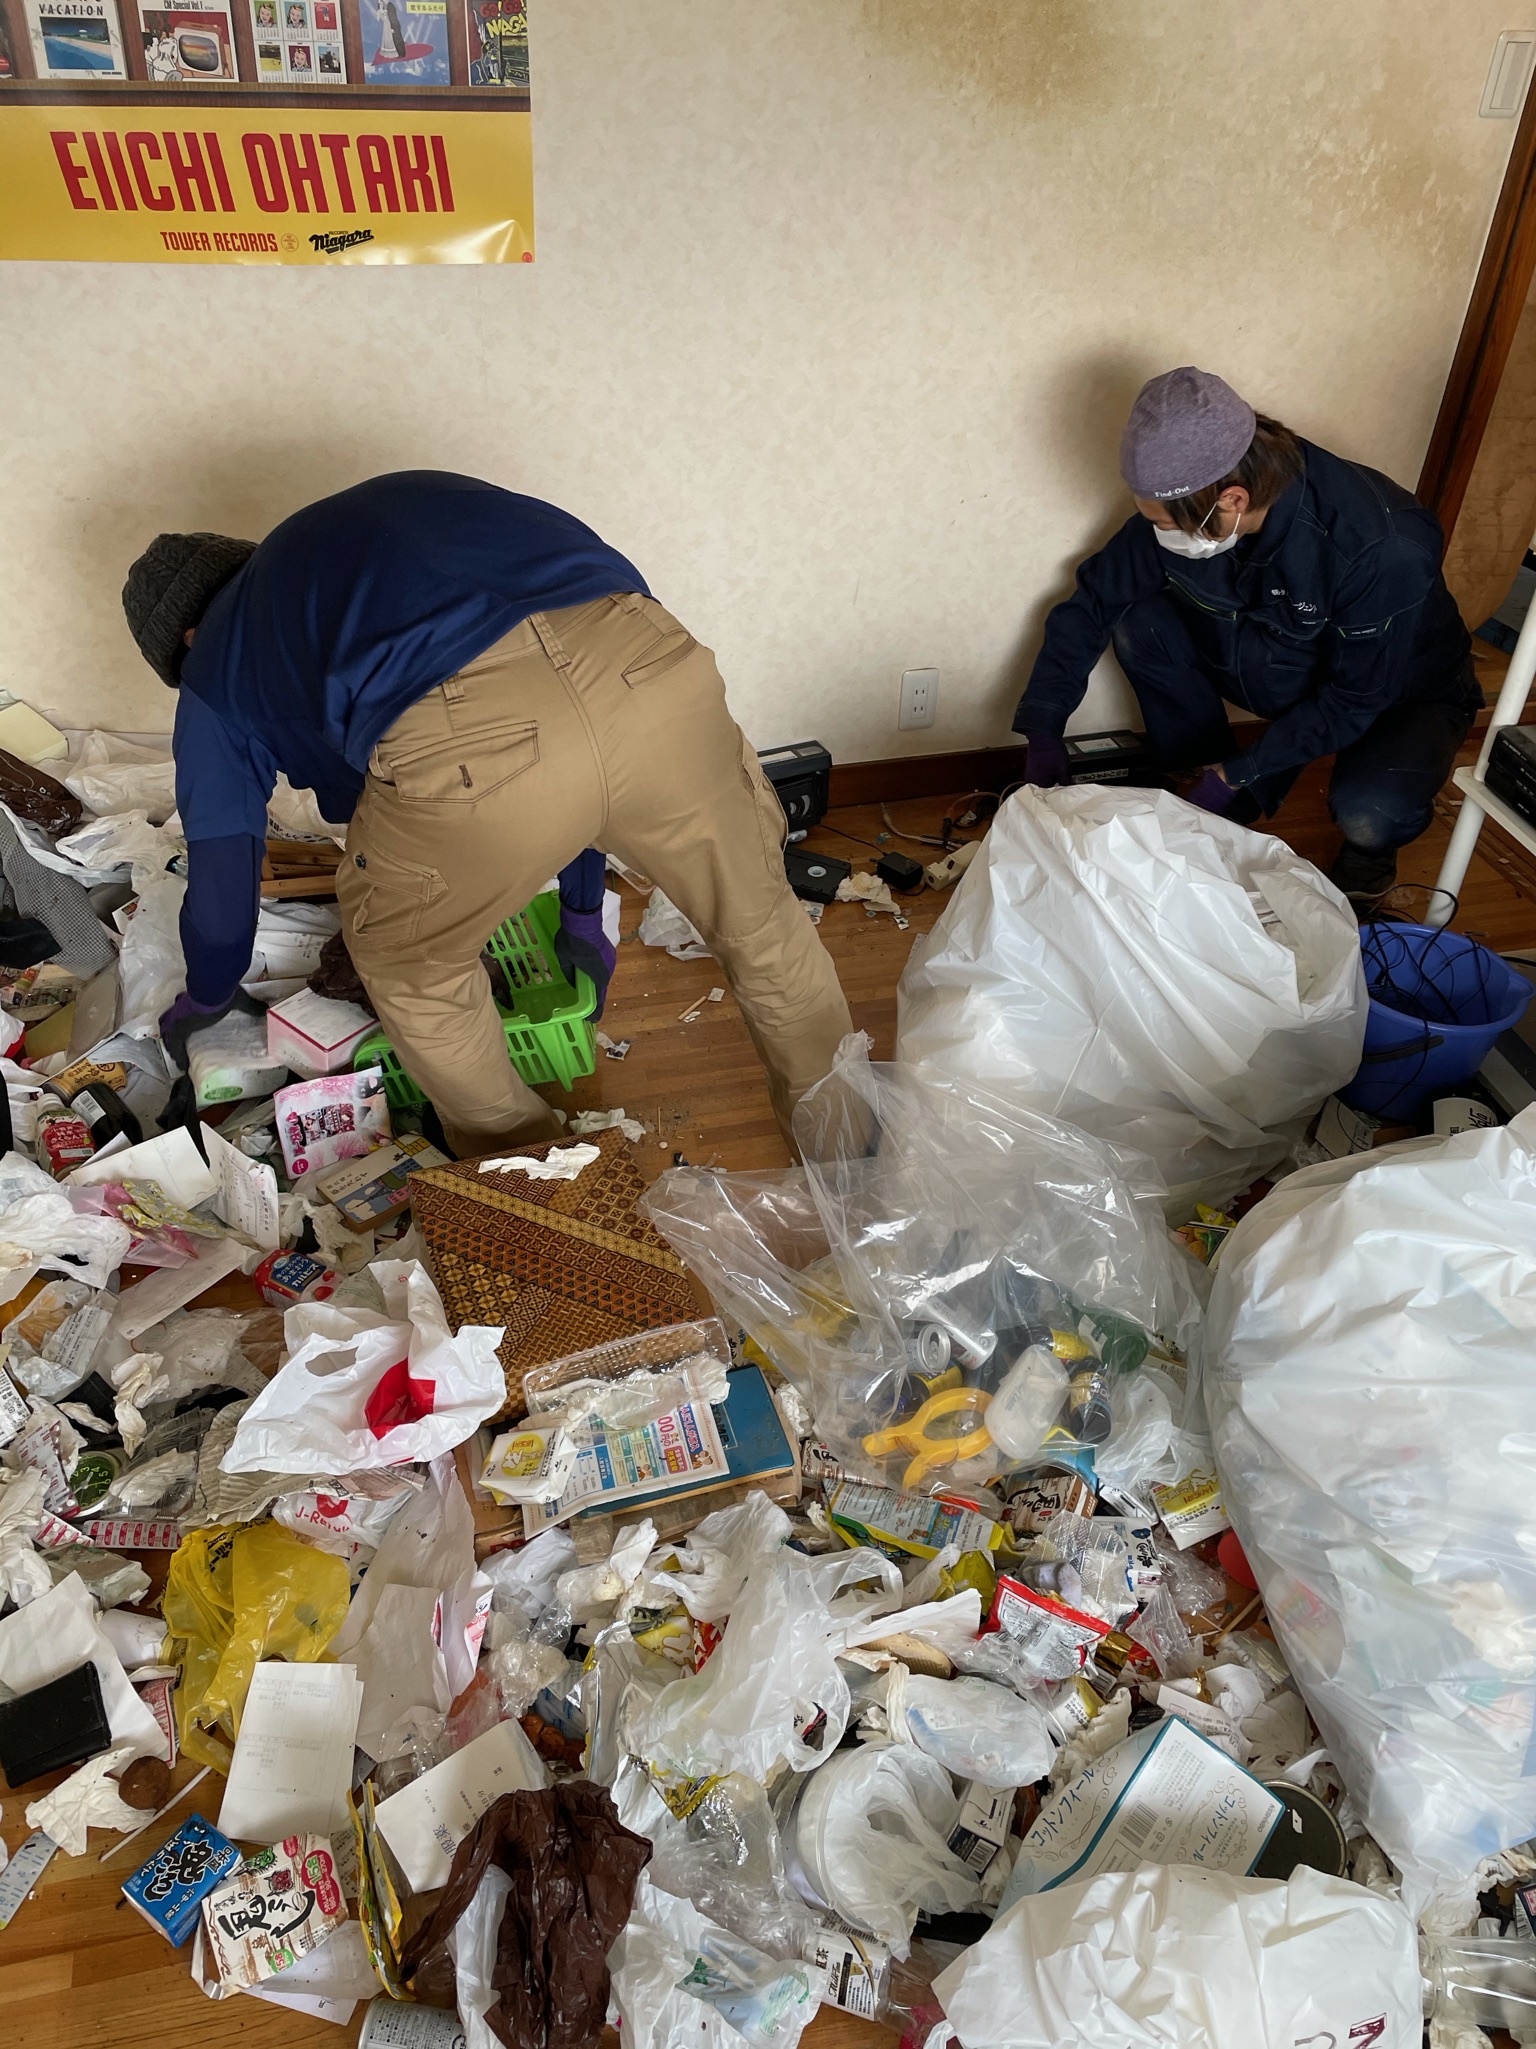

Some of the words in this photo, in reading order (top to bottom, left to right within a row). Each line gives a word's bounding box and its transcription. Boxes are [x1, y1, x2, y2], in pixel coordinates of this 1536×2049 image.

[38, 5, 104, 16] VACATION
[50, 131, 236, 212] EIICHI
[241, 133, 455, 213] OHTAKI
[160, 231, 212, 251] TOWER
[212, 232, 279, 252] RECORDS
[308, 229, 374, 252] Niagara
[1154, 485, 1191, 499] Find-Out
[282, 1257, 310, 1285] あまおう
[291, 1262, 320, 1290] カルピス
[1030, 1767, 1095, 1848] コットンフィール
[1191, 1796, 1236, 1862] コットンフィール
[137, 1828, 186, 1878] しぼりたて
[147, 1838, 216, 1902] 鬼ころし
